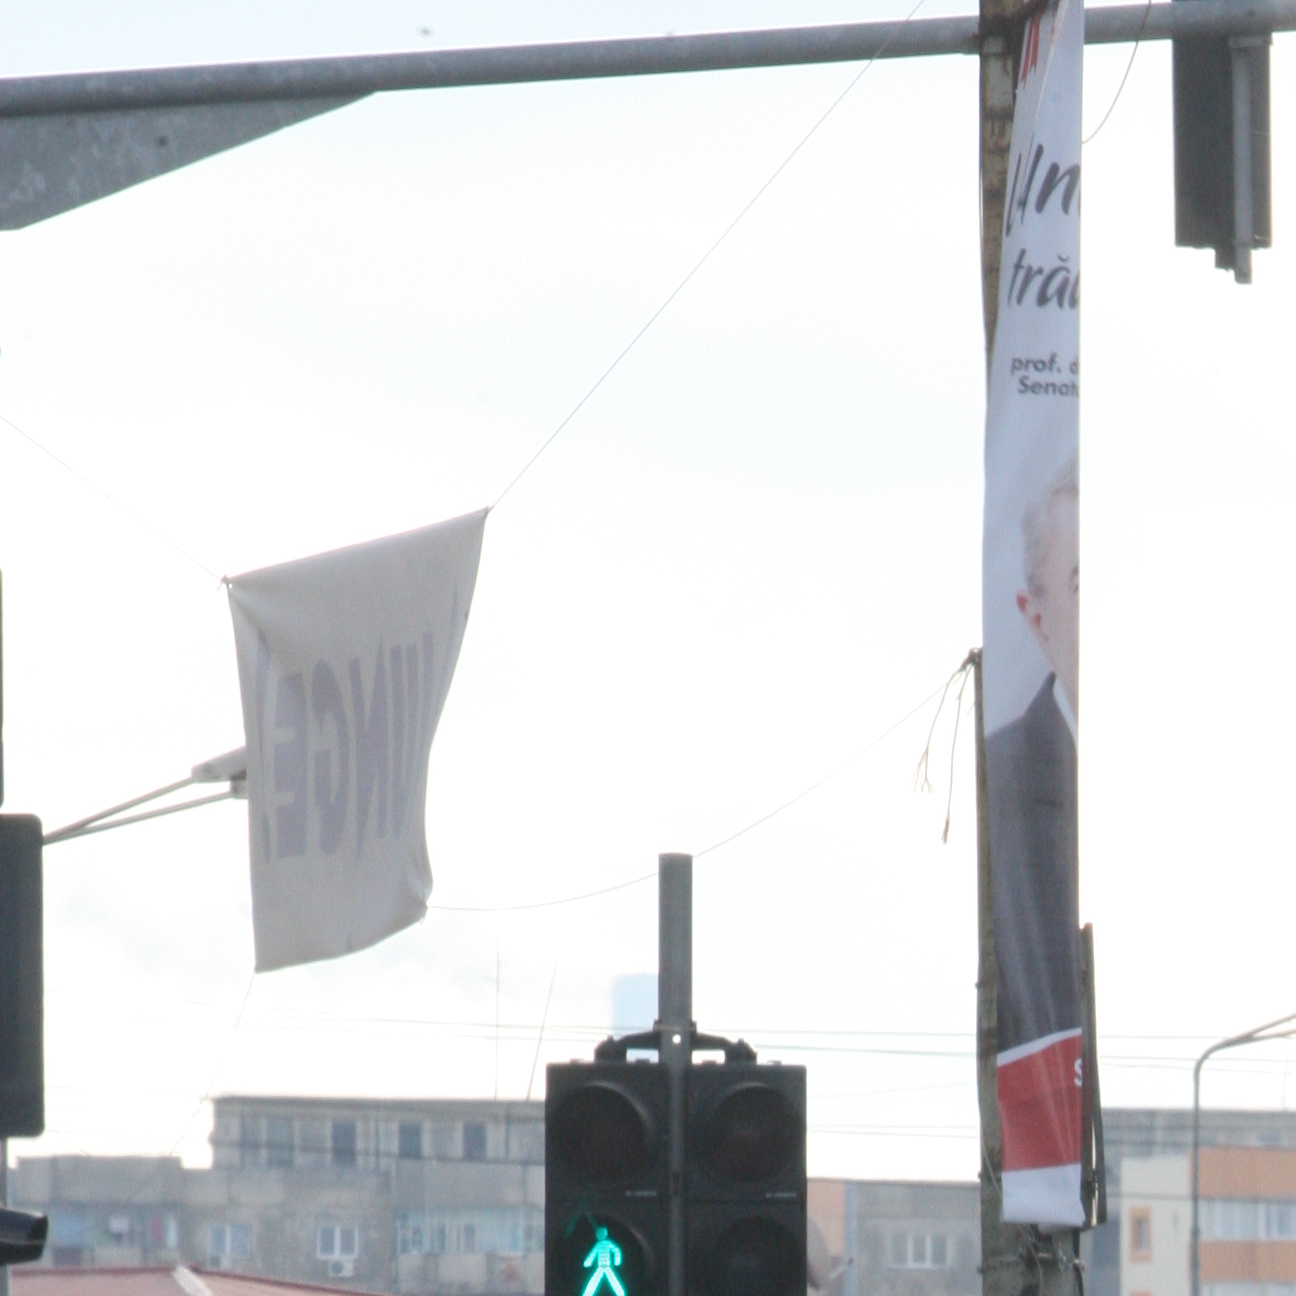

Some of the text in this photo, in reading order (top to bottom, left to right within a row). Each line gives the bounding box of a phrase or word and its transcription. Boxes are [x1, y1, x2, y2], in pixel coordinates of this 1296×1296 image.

[1004, 143, 1080, 237] Un
[1010, 352, 1062, 377] prof.
[1073, 1057, 1083, 1088] S
